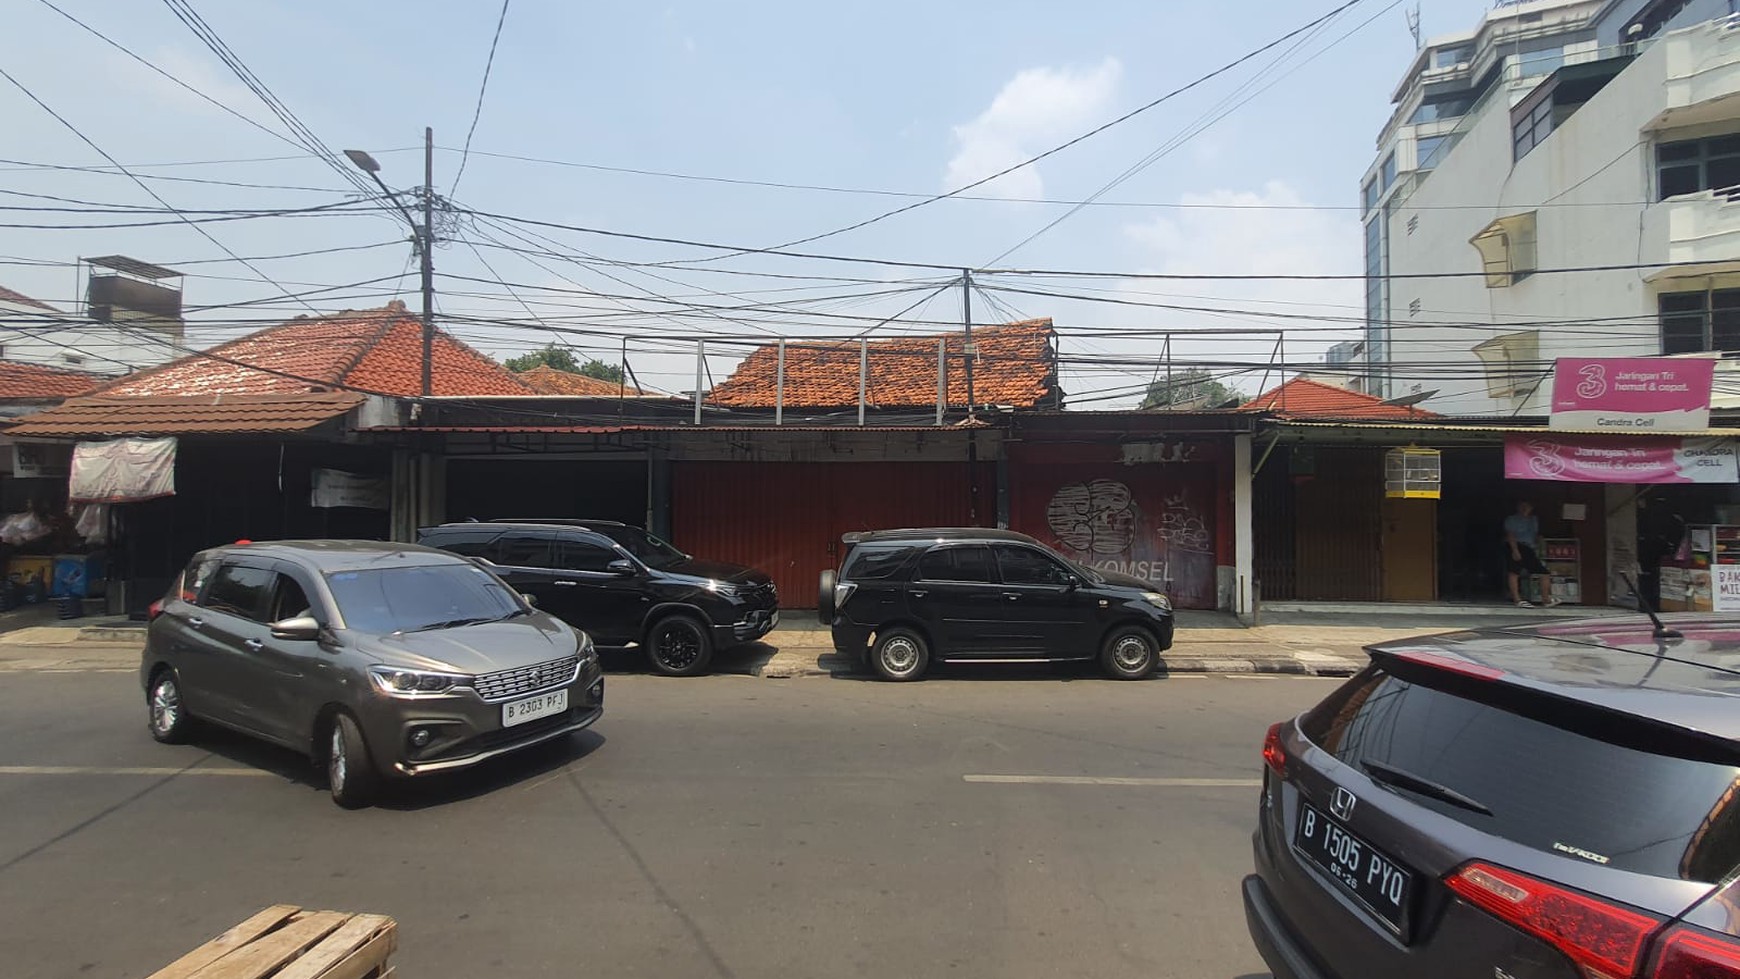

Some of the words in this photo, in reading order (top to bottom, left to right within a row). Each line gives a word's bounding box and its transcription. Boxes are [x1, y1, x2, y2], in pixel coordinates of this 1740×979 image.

[1615, 371, 1660, 382] Jaringan
[1661, 371, 1675, 381] Tri
[1648, 383, 1657, 392] &
[1597, 418, 1633, 427] Candra
[1635, 418, 1656, 427] Cell
[1574, 447, 1628, 459] Jaringan
[1697, 459, 1722, 467] CELL
[509, 706, 515, 718] B
[520, 699, 543, 715] 2303
[1304, 809, 1317, 838] B
[1323, 823, 1362, 872] 1505
[1367, 854, 1404, 907] PYQ
